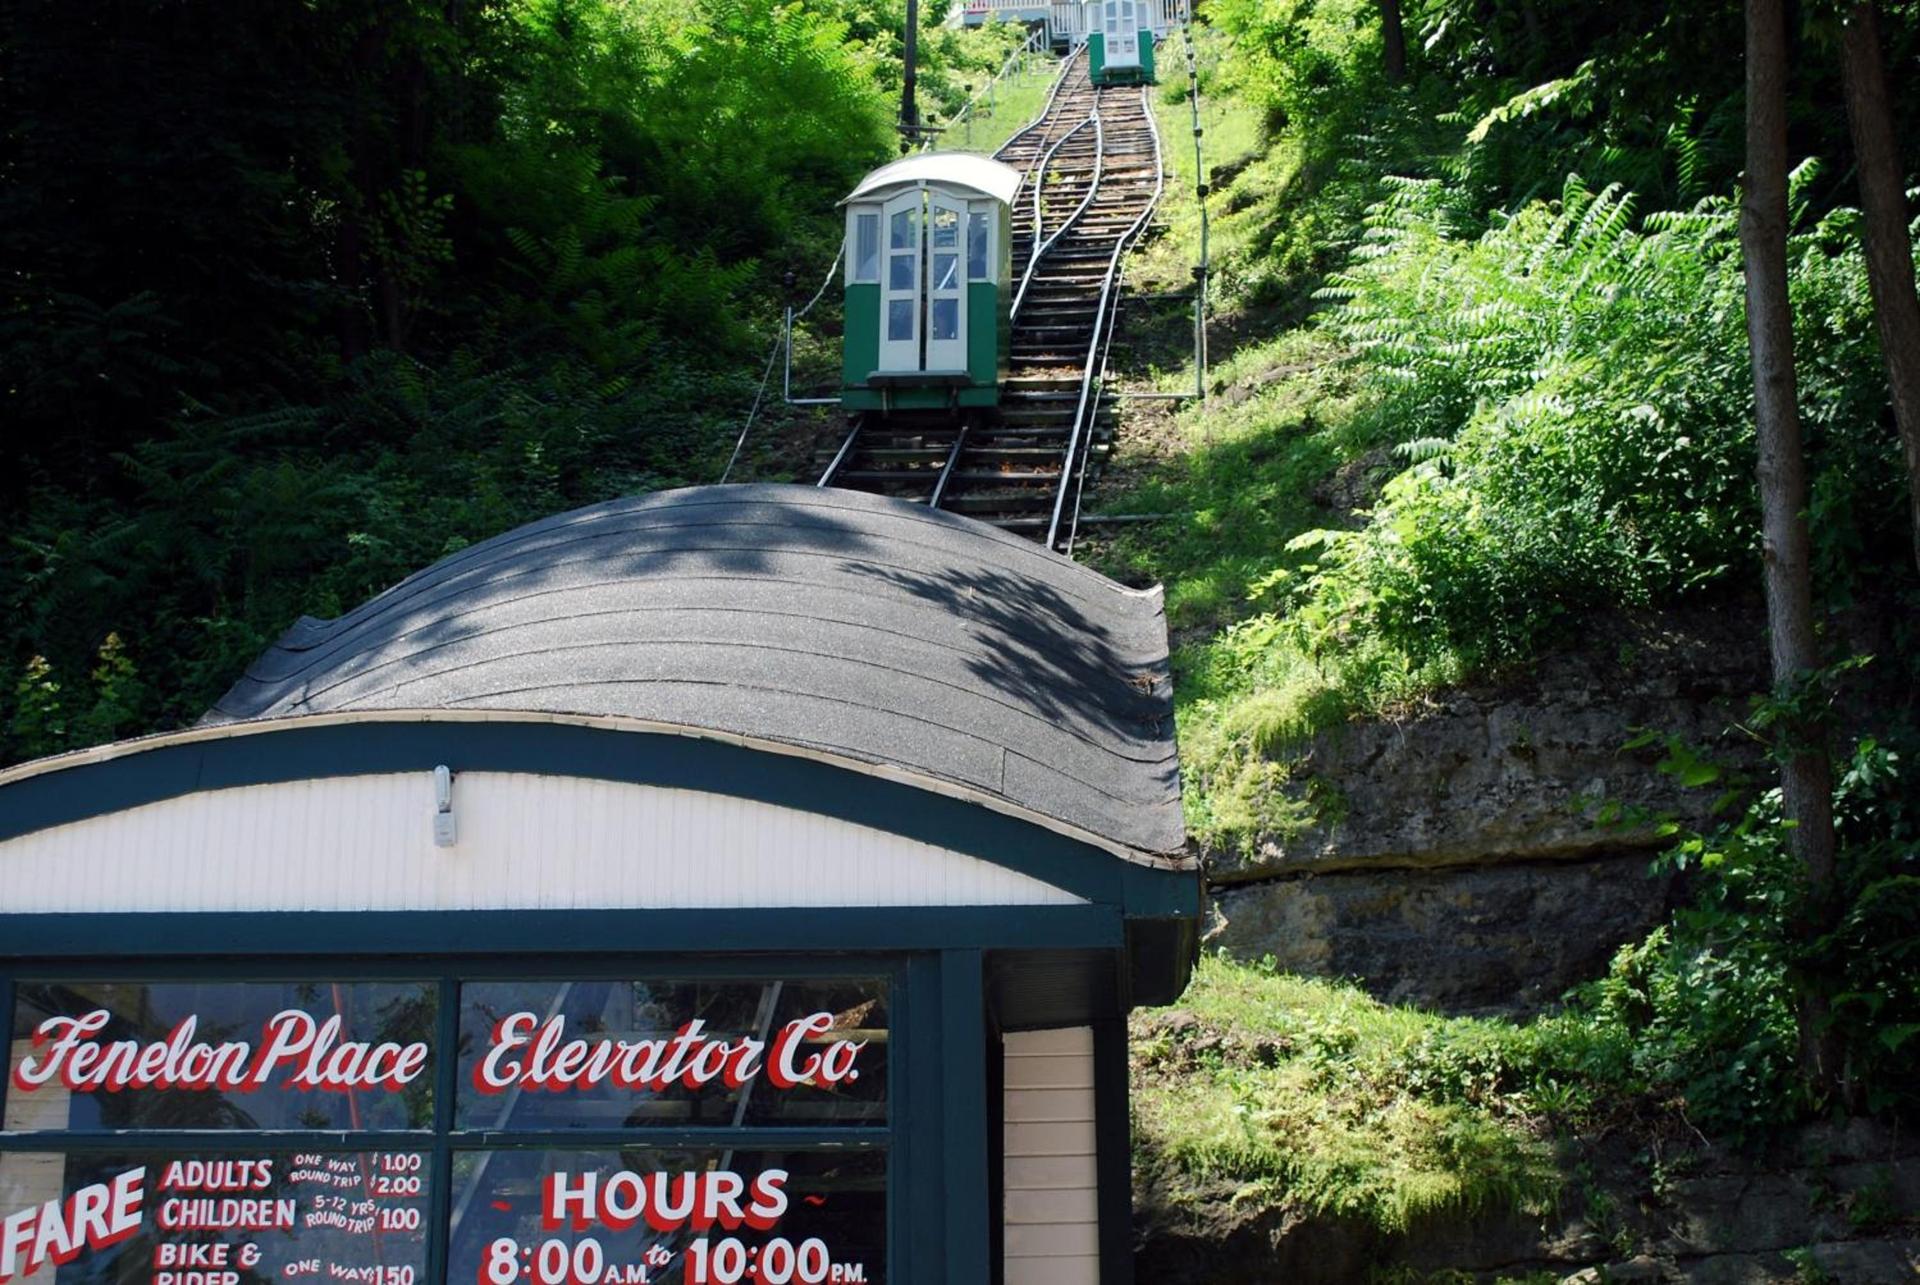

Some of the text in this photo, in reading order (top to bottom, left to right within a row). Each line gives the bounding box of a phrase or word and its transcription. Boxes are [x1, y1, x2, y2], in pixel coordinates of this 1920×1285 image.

[16, 1009, 868, 1088] Fenelon Place Elevator Co.
[163, 1159, 273, 1189] ADULTS
[294, 1154, 322, 1166] ONE
[328, 1159, 356, 1173] WAY
[290, 1169, 331, 1183] ROUND
[333, 1175, 361, 1187] TRIP
[314, 1195, 347, 1211] 5-12
[551, 1169, 789, 1220] HOURS
[0, 1165, 147, 1276] FARE
[162, 1198, 296, 1227] CHILDREN
[305, 1211, 347, 1228] ROUND
[347, 1217, 375, 1233] TRIP
[159, 1242, 262, 1267] BIKE &
[645, 1243, 678, 1266] to
[285, 1259, 321, 1275] ONE
[330, 1262, 372, 1280] WAY
